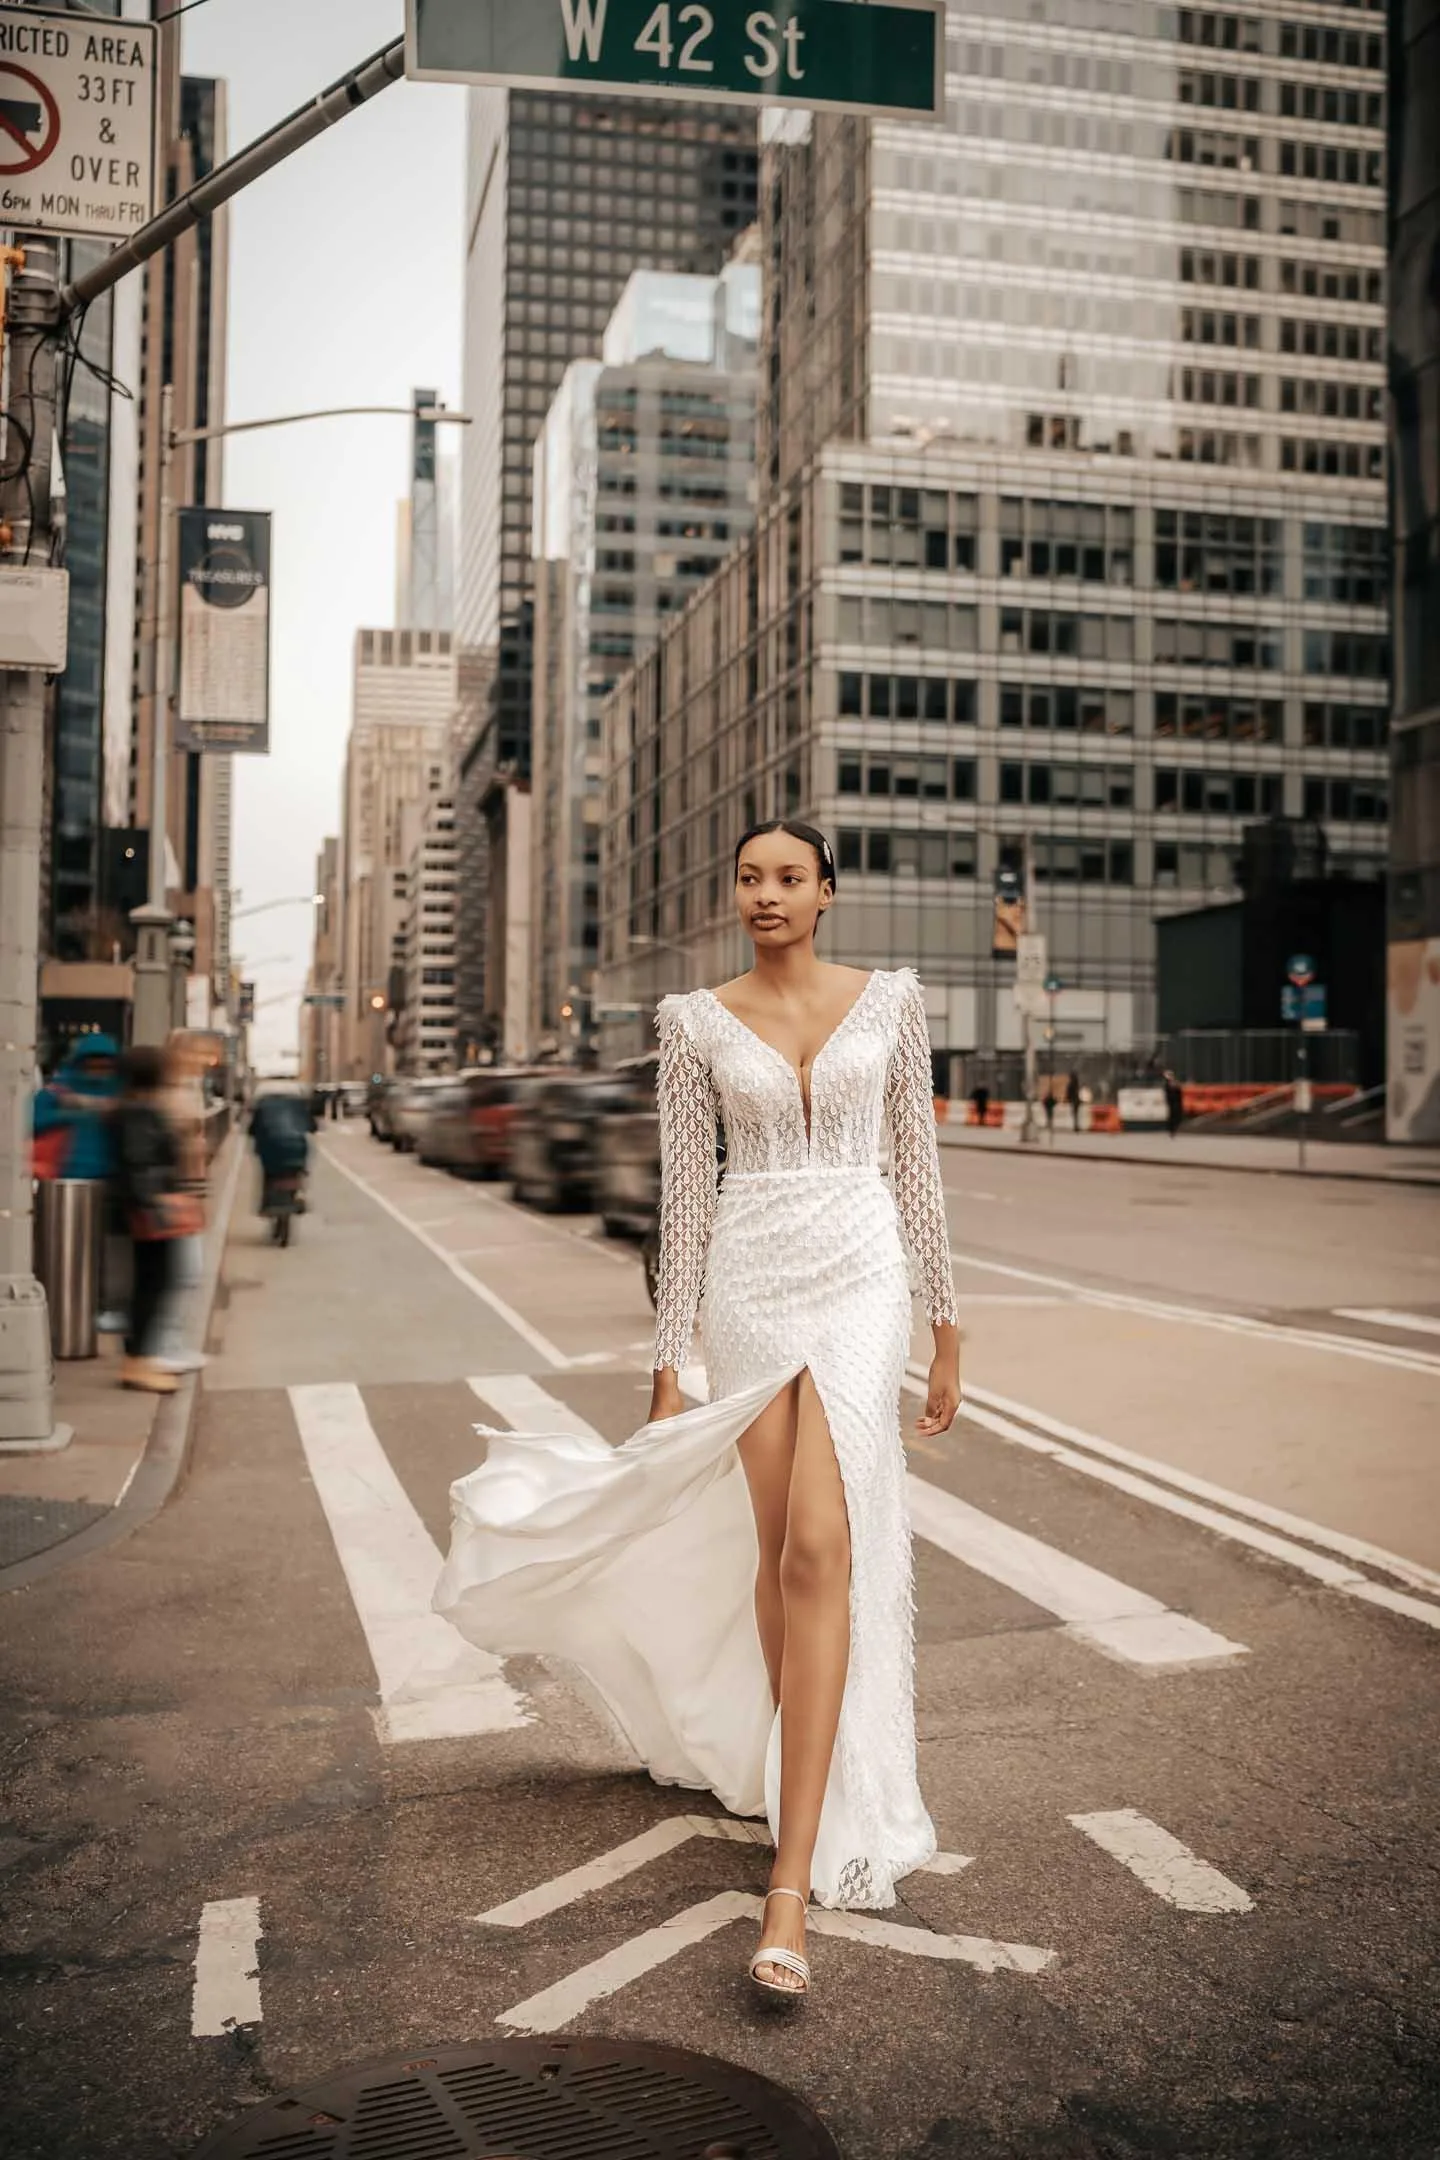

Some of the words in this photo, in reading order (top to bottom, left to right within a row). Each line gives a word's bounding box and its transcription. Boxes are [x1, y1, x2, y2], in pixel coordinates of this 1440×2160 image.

[84, 35, 144, 68] AREA
[561, 0, 608, 62] W
[633, 3, 714, 72] 42
[744, 11, 806, 80] St
[99, 117, 116, 145] &
[71, 154, 140, 188] OVER
[41, 192, 80, 217] MON
[118, 201, 145, 223] FRI
